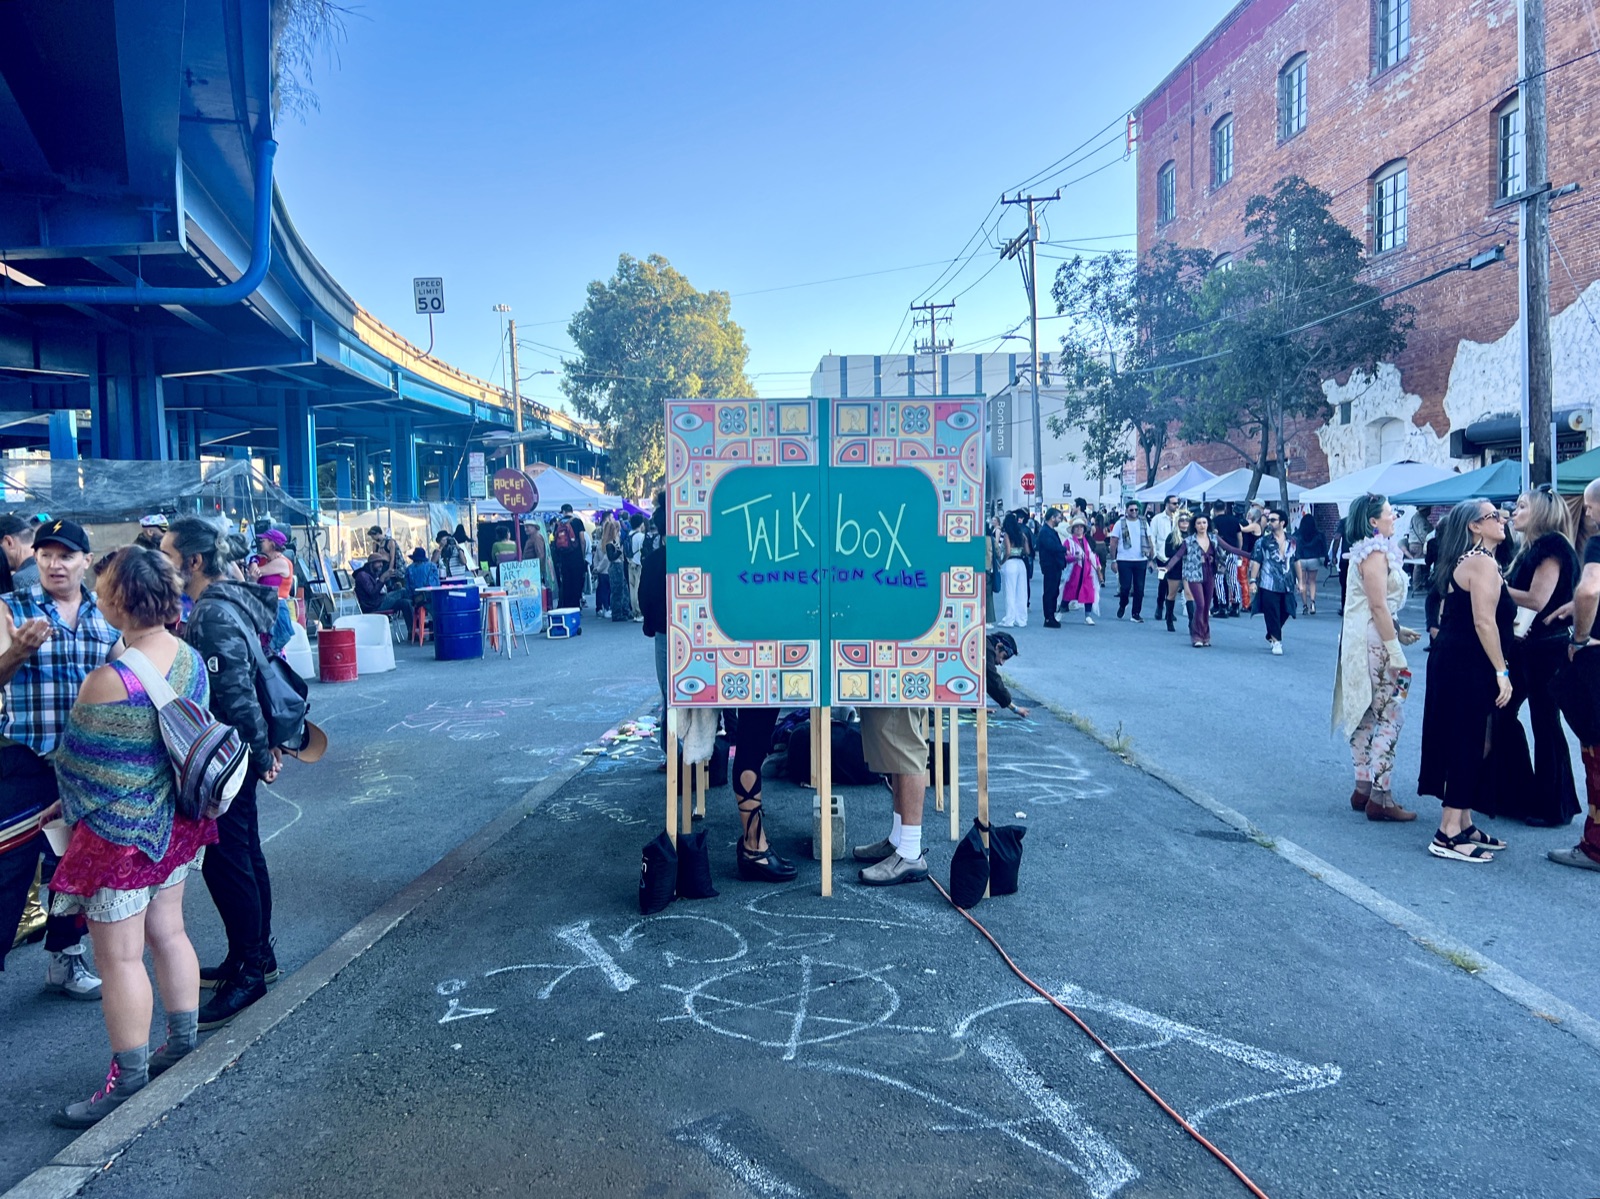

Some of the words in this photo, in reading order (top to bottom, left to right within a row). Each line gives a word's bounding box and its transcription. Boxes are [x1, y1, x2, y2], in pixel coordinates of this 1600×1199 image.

[418, 297, 441, 310] 50
[997, 401, 1006, 451] Bonhams
[493, 478, 525, 491] ROCKET
[503, 493, 527, 506] FUEL
[721, 491, 815, 564] TALK
[503, 570, 521, 580] ART
